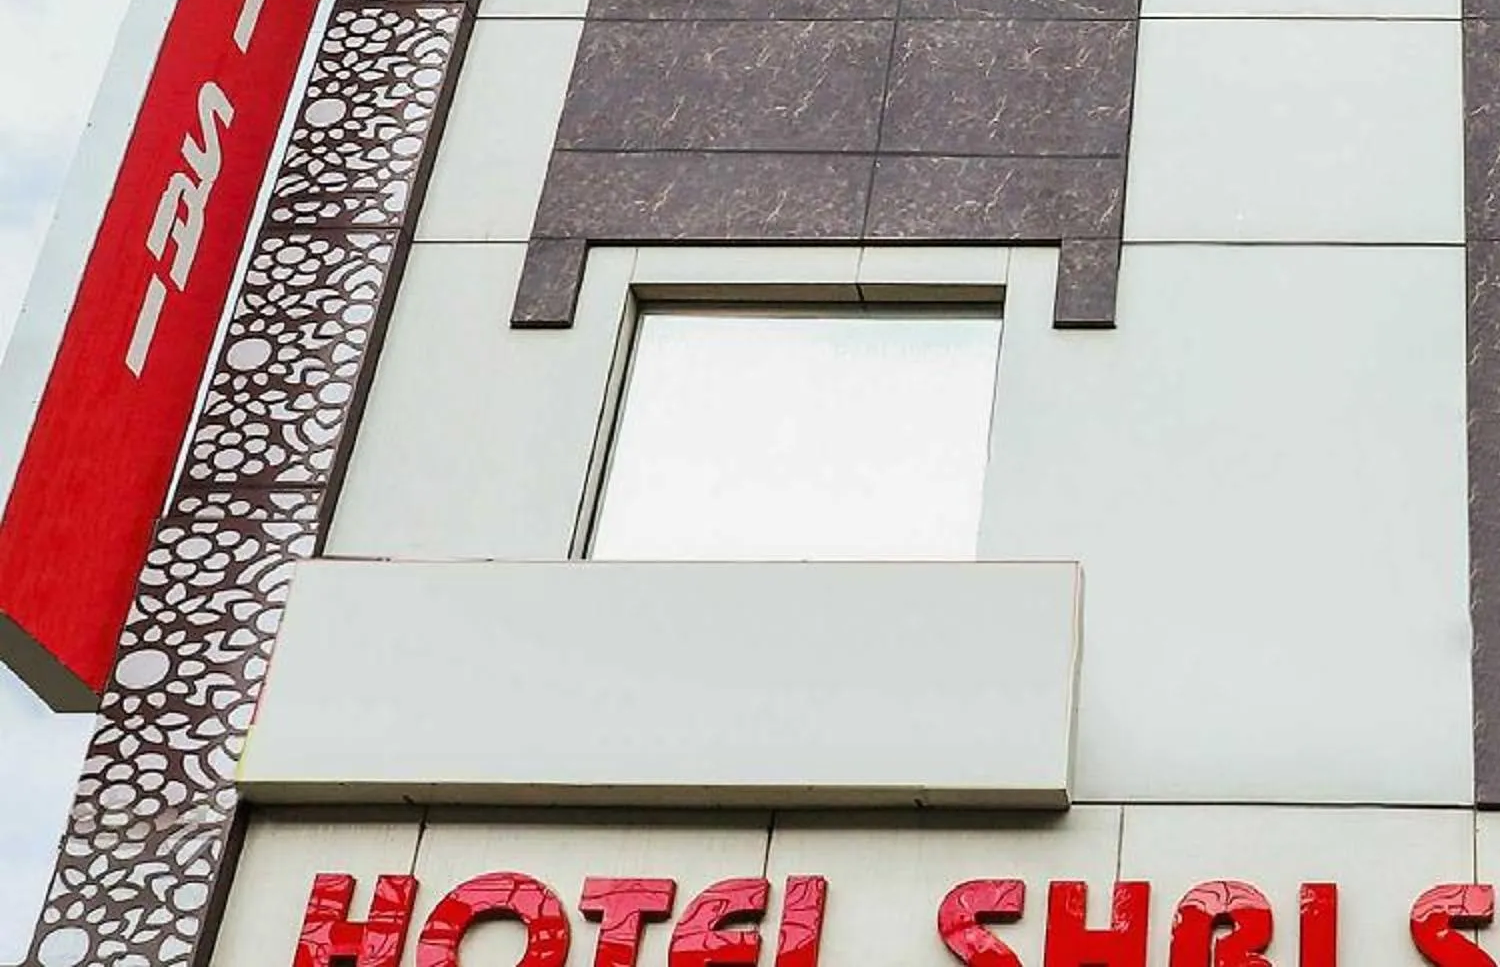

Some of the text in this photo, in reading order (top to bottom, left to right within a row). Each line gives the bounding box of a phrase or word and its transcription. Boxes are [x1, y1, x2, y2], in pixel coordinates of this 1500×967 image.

[124, 80, 235, 379] SAI
[291, 871, 828, 967] HOTEL
[937, 878, 1339, 967] SHRI
